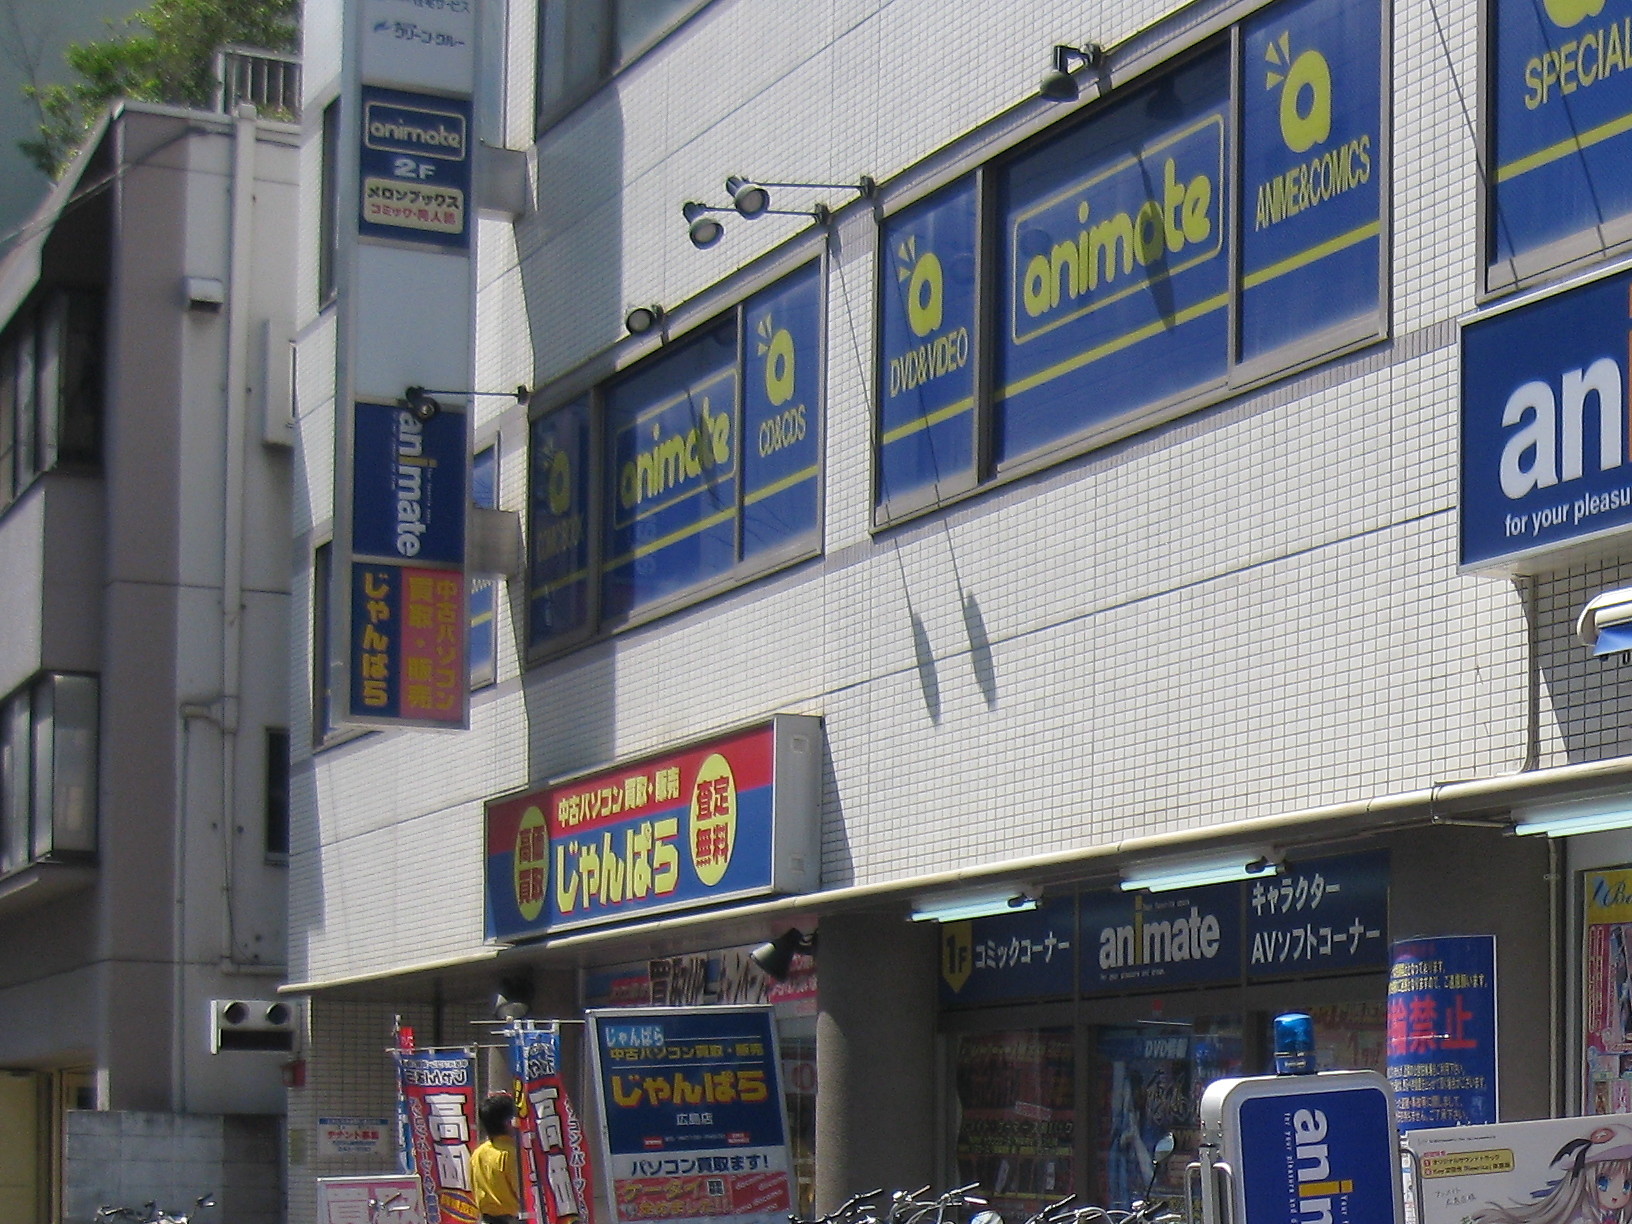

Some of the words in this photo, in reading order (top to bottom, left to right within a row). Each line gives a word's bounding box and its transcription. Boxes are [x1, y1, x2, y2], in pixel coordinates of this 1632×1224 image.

[370, 119, 461, 148] animate
[393, 159, 436, 179] 2F
[1254, 134, 1372, 232] ANIME&COMICS
[367, 185, 460, 209] メロンブックス
[1022, 157, 1213, 319] animate
[889, 327, 969, 399] DVD&VIDEO
[620, 397, 732, 509] animate
[397, 411, 438, 558] animate
[1504, 511, 1528, 539] for
[1531, 502, 1569, 536] your
[556, 817, 679, 915] じゃんぱら
[1252, 873, 1341, 916] キャラクター
[975, 931, 1070, 969] コミックコーナー
[1100, 895, 1220, 970] animate
[1251, 917, 1380, 965] AVソフトコーナー
[947, 934, 968, 975] 1F
[611, 1070, 769, 1108] じゃんぱら
[676, 1112, 714, 1126] 広島店
